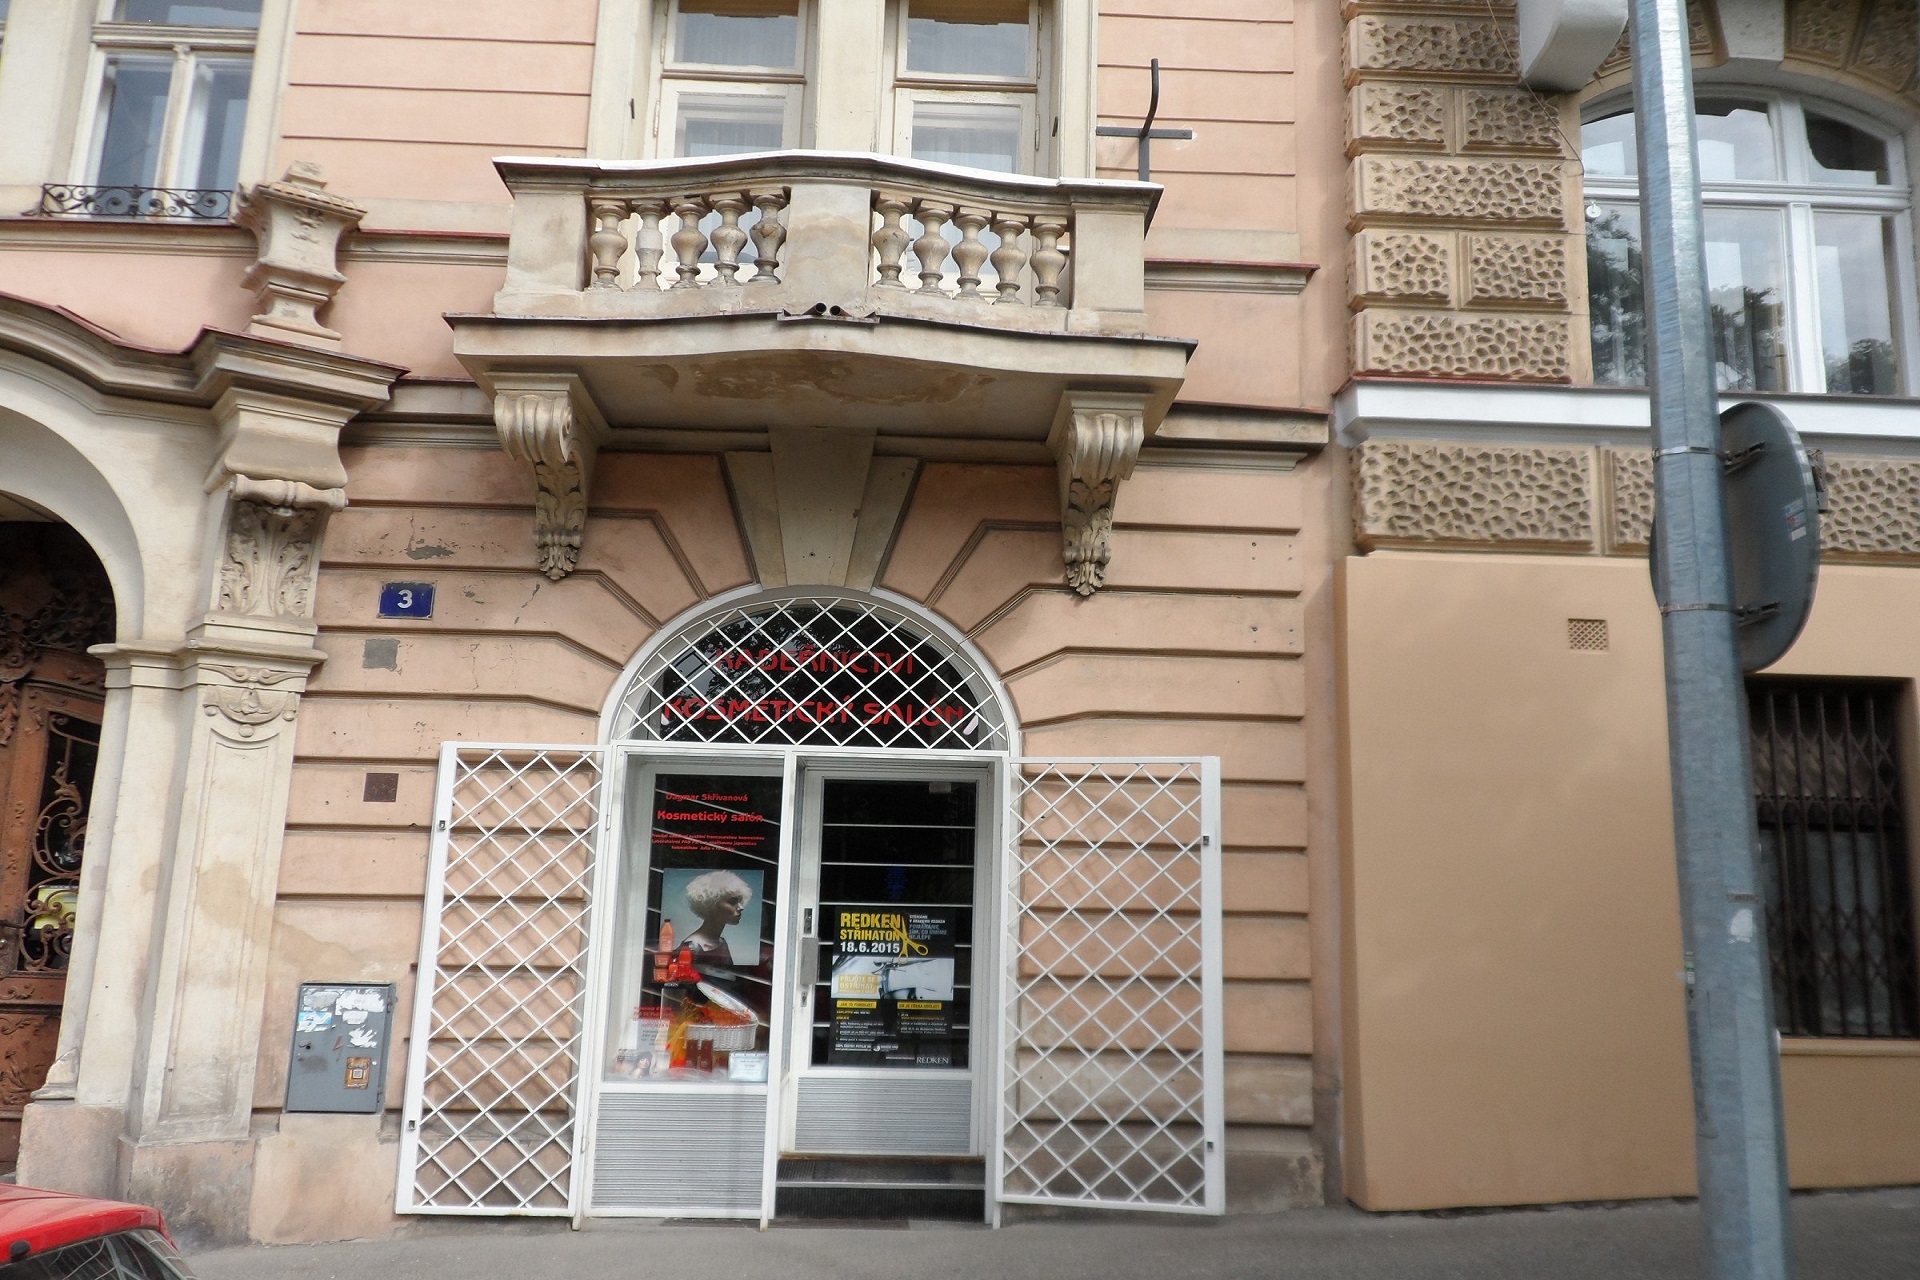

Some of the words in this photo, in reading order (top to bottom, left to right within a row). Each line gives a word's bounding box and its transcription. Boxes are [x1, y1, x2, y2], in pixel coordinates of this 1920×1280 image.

[397, 589, 413, 609] 3
[663, 695, 854, 724] KOSMETICKÝ
[862, 697, 964, 727] SALÓN
[701, 793, 748, 802] Skřivanová
[657, 810, 727, 823] Kosmetický
[840, 912, 900, 928] REDKEN
[840, 929, 900, 941] STŘIHATON
[916, 1056, 949, 1064] REDKEN
